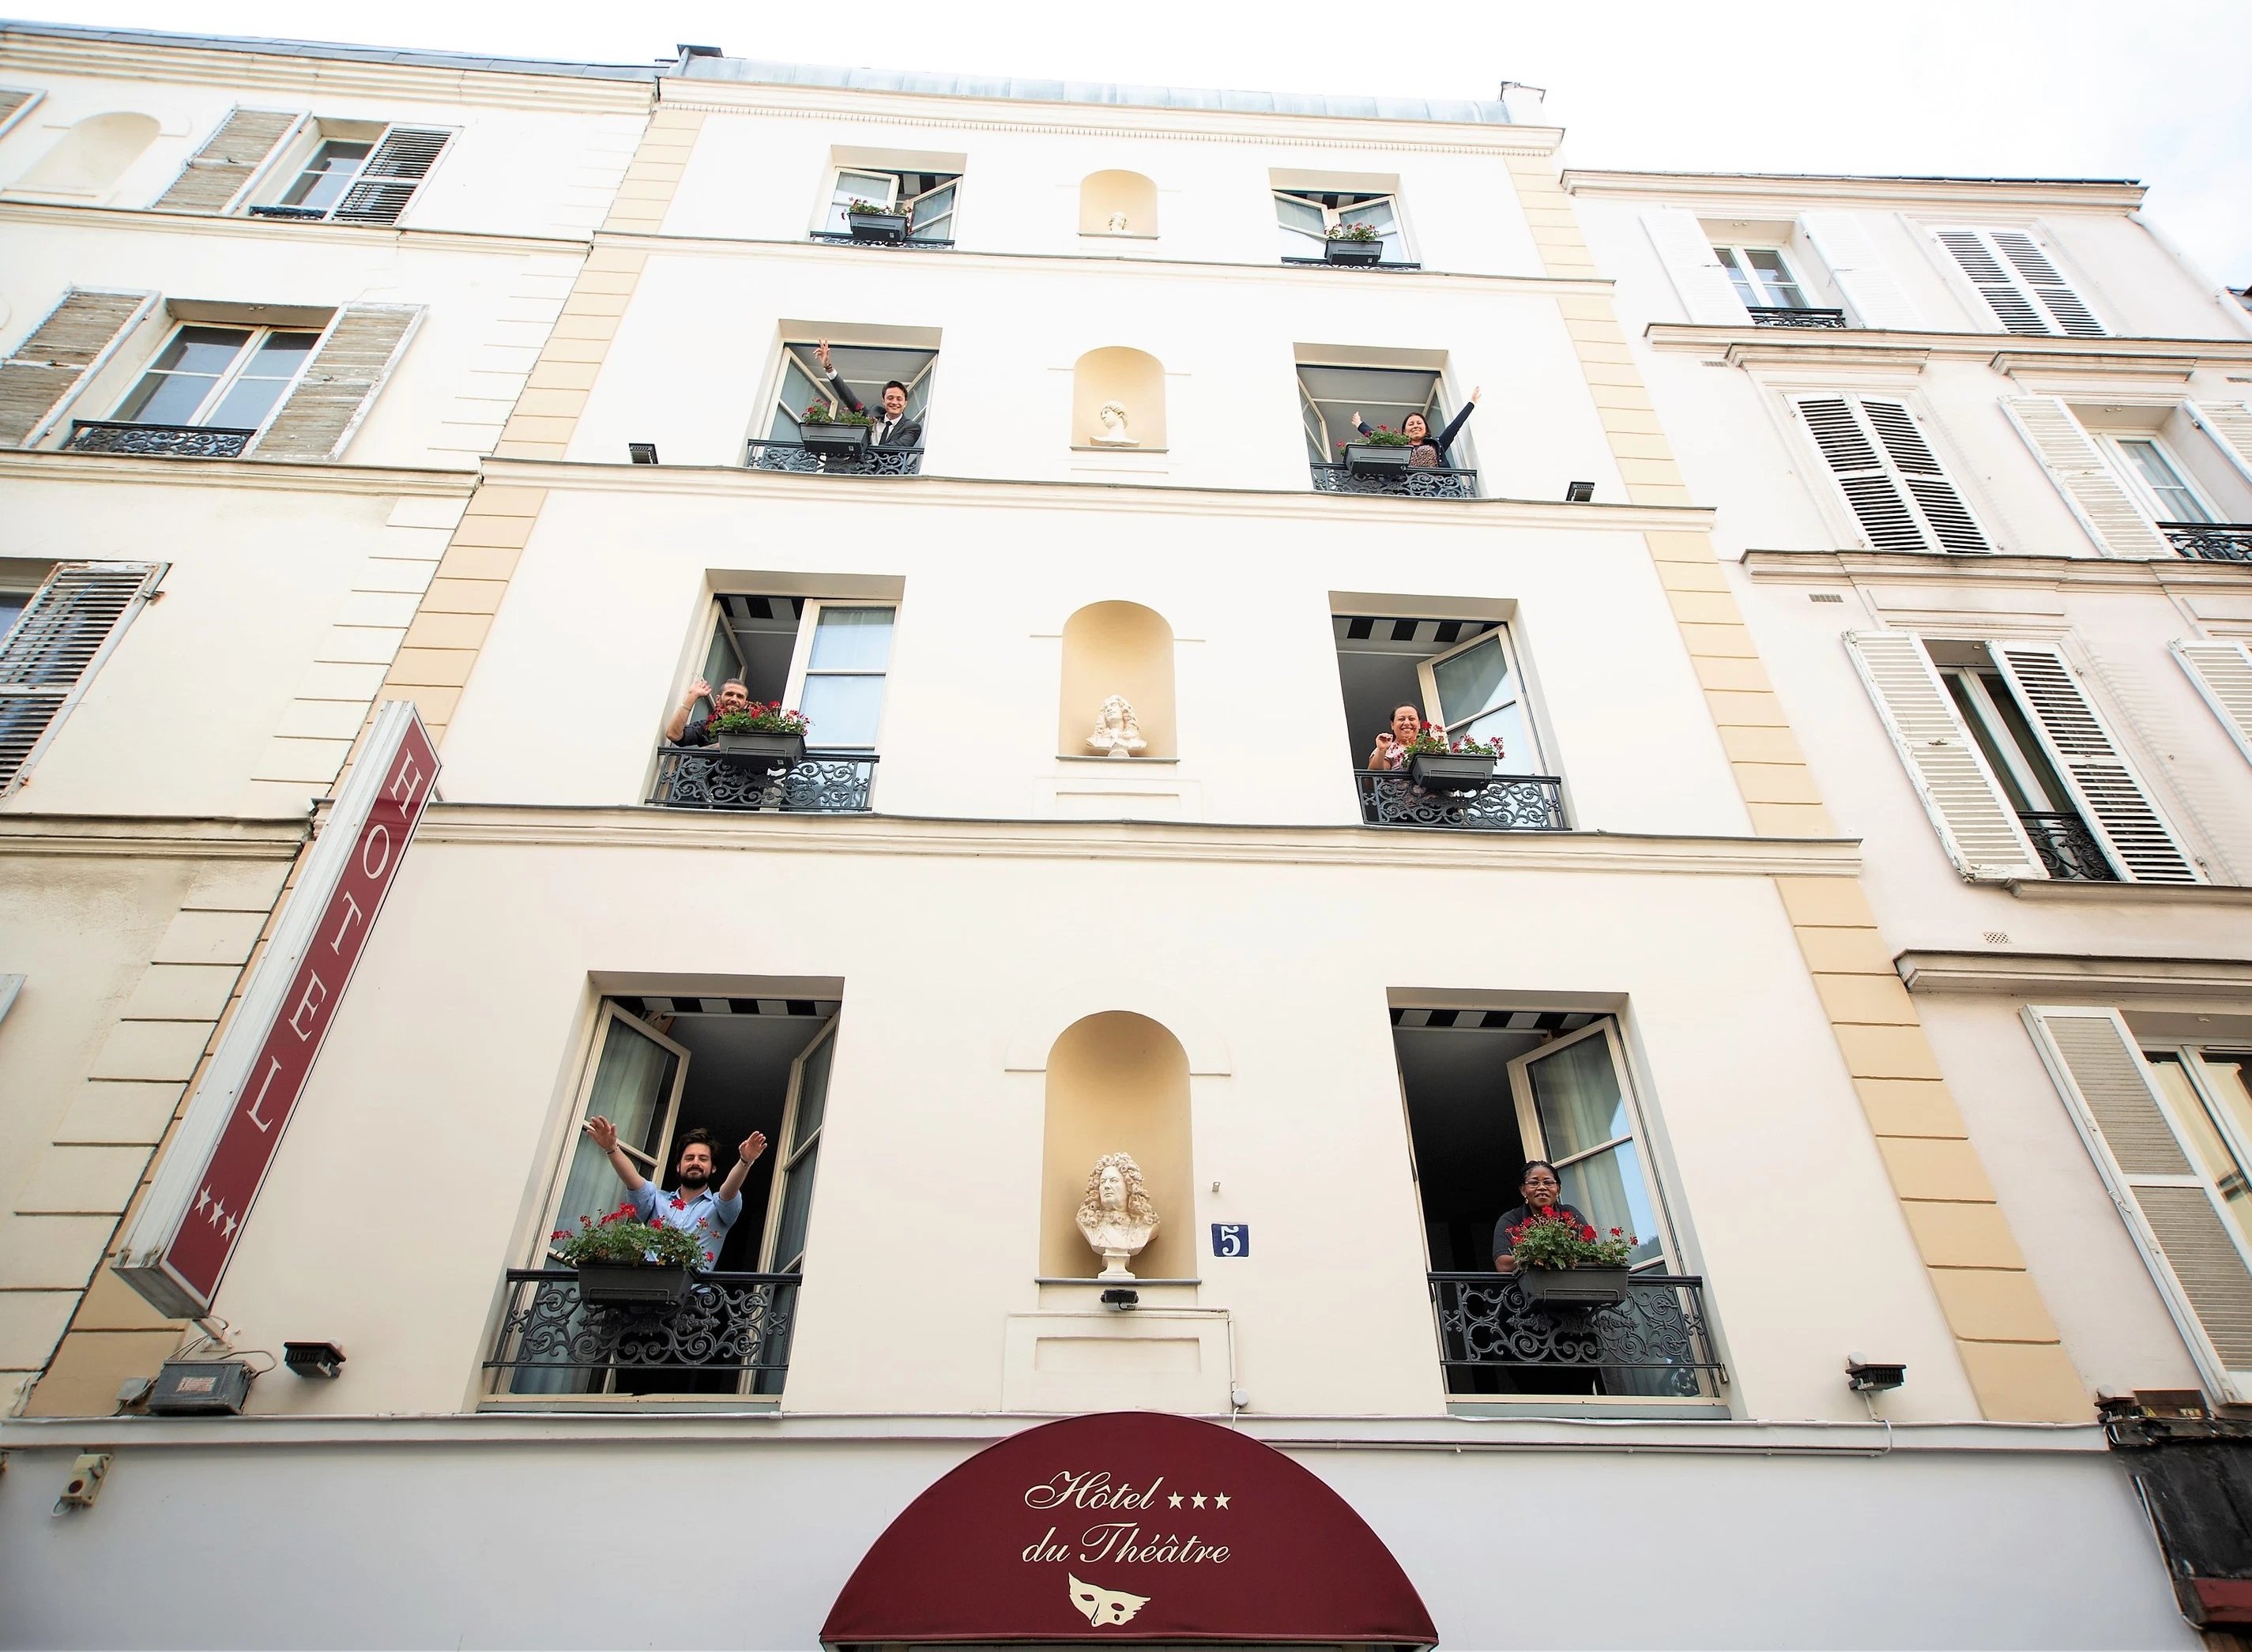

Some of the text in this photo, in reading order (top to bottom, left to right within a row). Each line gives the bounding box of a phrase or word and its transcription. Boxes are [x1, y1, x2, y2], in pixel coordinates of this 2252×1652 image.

[247, 748, 423, 1133] HOTEL
[1220, 1225, 1241, 1256] 5
[1024, 1470, 1164, 1510] Hôtel
[1022, 1522, 1231, 1564] du Théâtre
